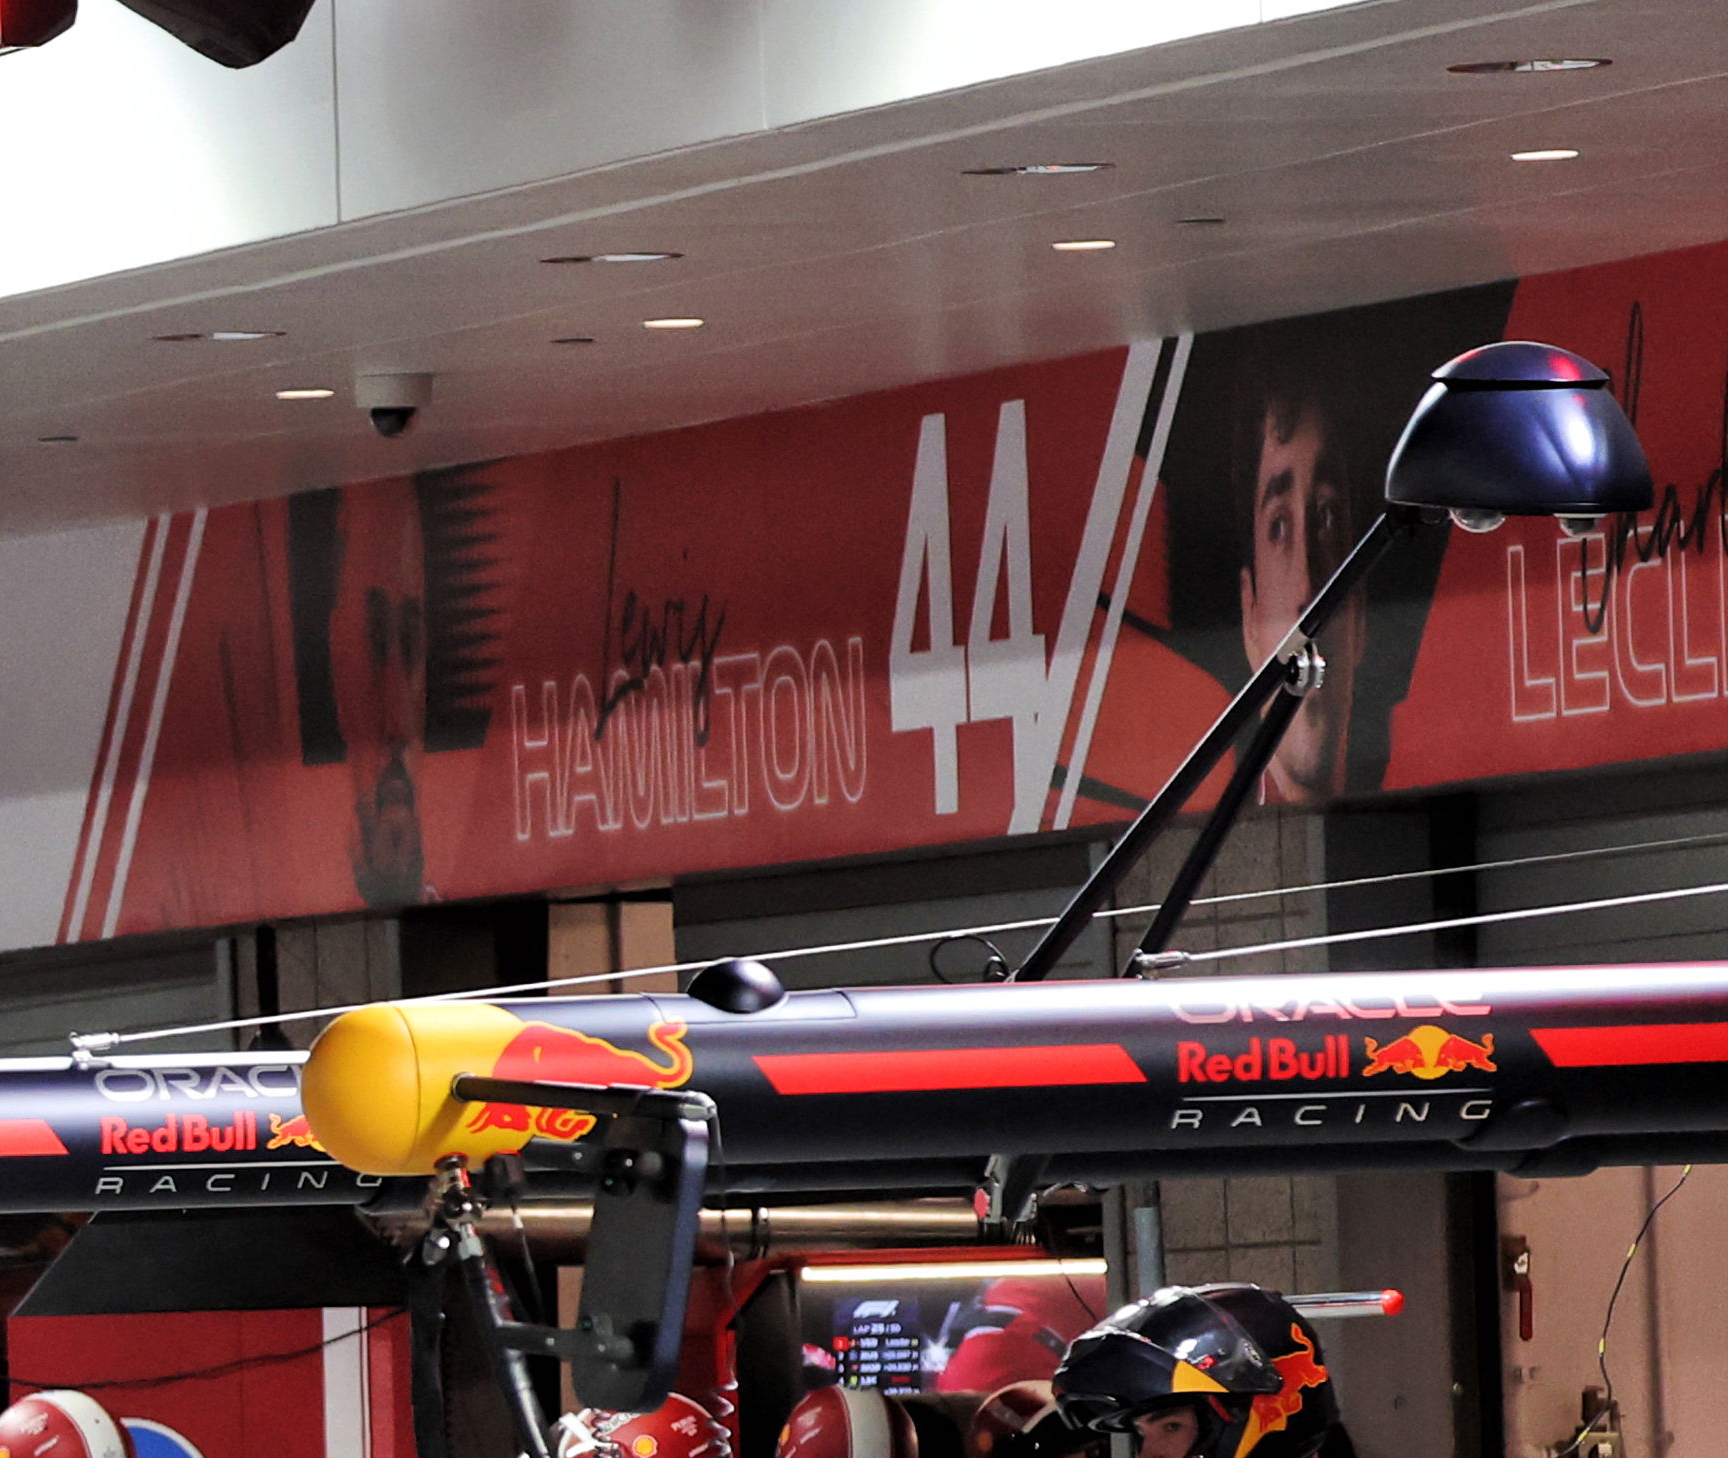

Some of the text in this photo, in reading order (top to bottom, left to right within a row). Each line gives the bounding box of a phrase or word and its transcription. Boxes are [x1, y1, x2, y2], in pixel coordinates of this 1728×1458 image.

[889, 399, 1050, 834] 44
[1507, 510, 1728, 722] LECL
[510, 636, 868, 841] HAMILTON
[1176, 1034, 1349, 1082] Red Bull
[95, 1064, 303, 1101] ORAC
[100, 1111, 257, 1154] Red Bull
[1170, 1100, 1492, 1129] RACING
